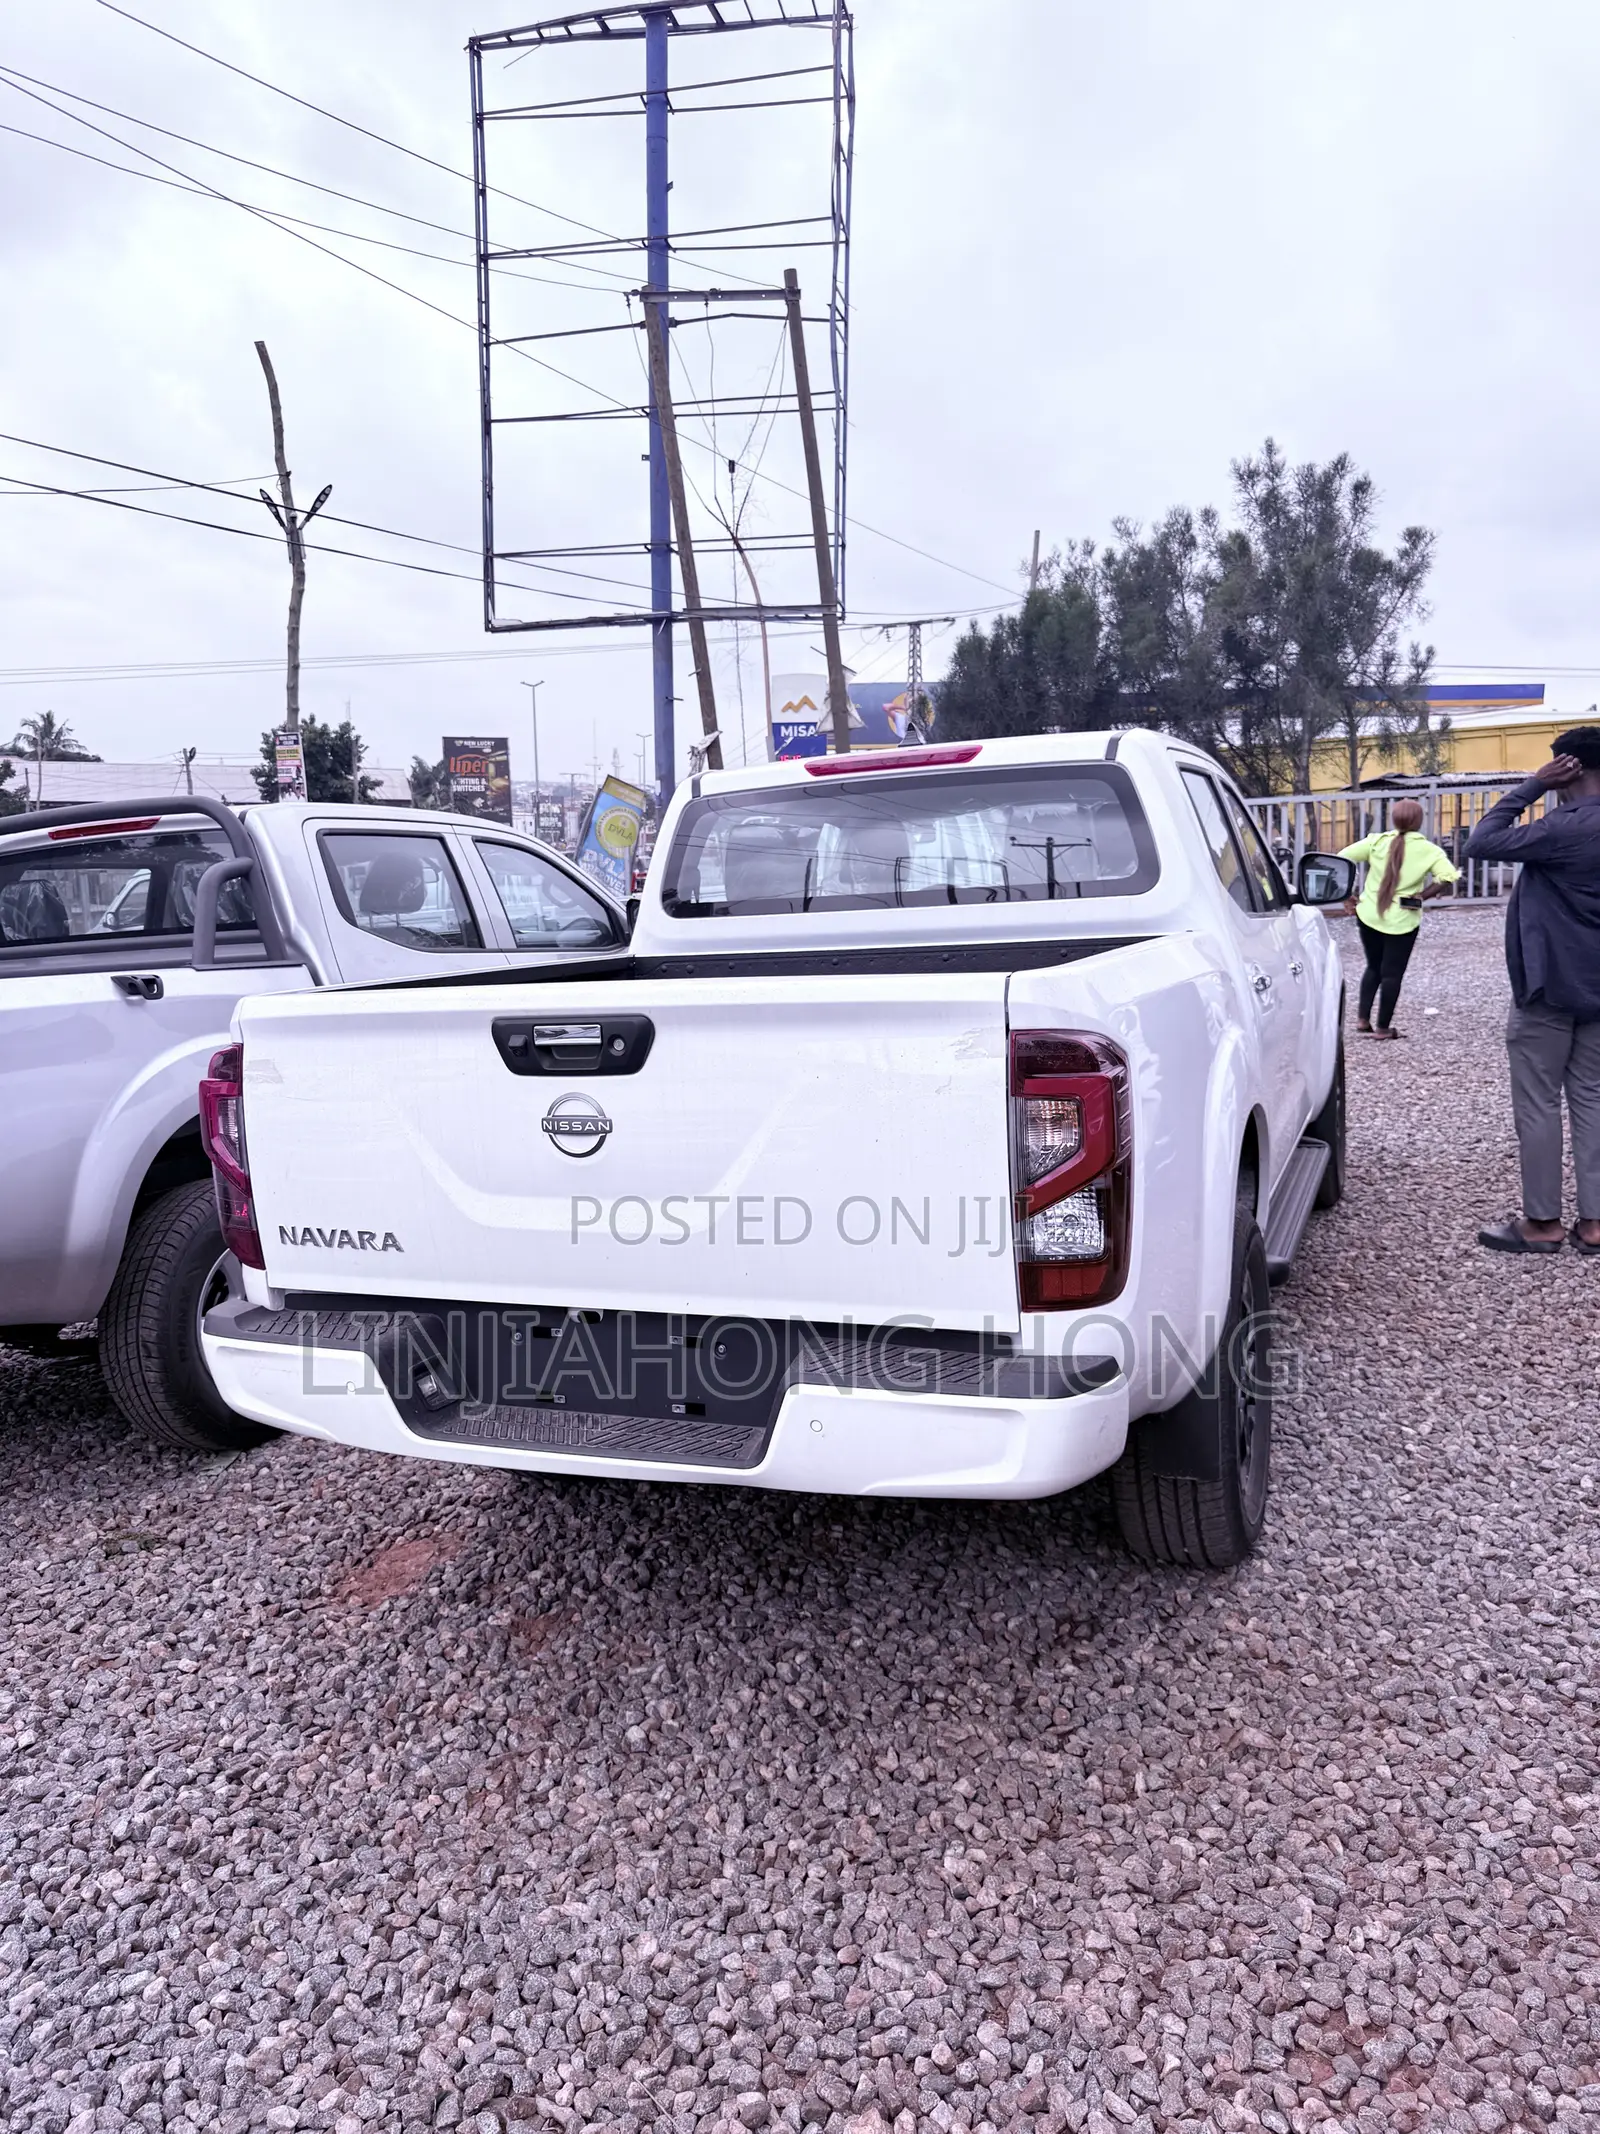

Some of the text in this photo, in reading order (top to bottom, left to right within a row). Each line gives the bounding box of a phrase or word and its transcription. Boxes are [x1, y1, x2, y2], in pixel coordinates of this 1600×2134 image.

[781, 725, 818, 737] MISA
[608, 823, 633, 841] DVLA
[542, 1120, 610, 1131] NISSAN
[278, 1224, 404, 1253] NAVARA
